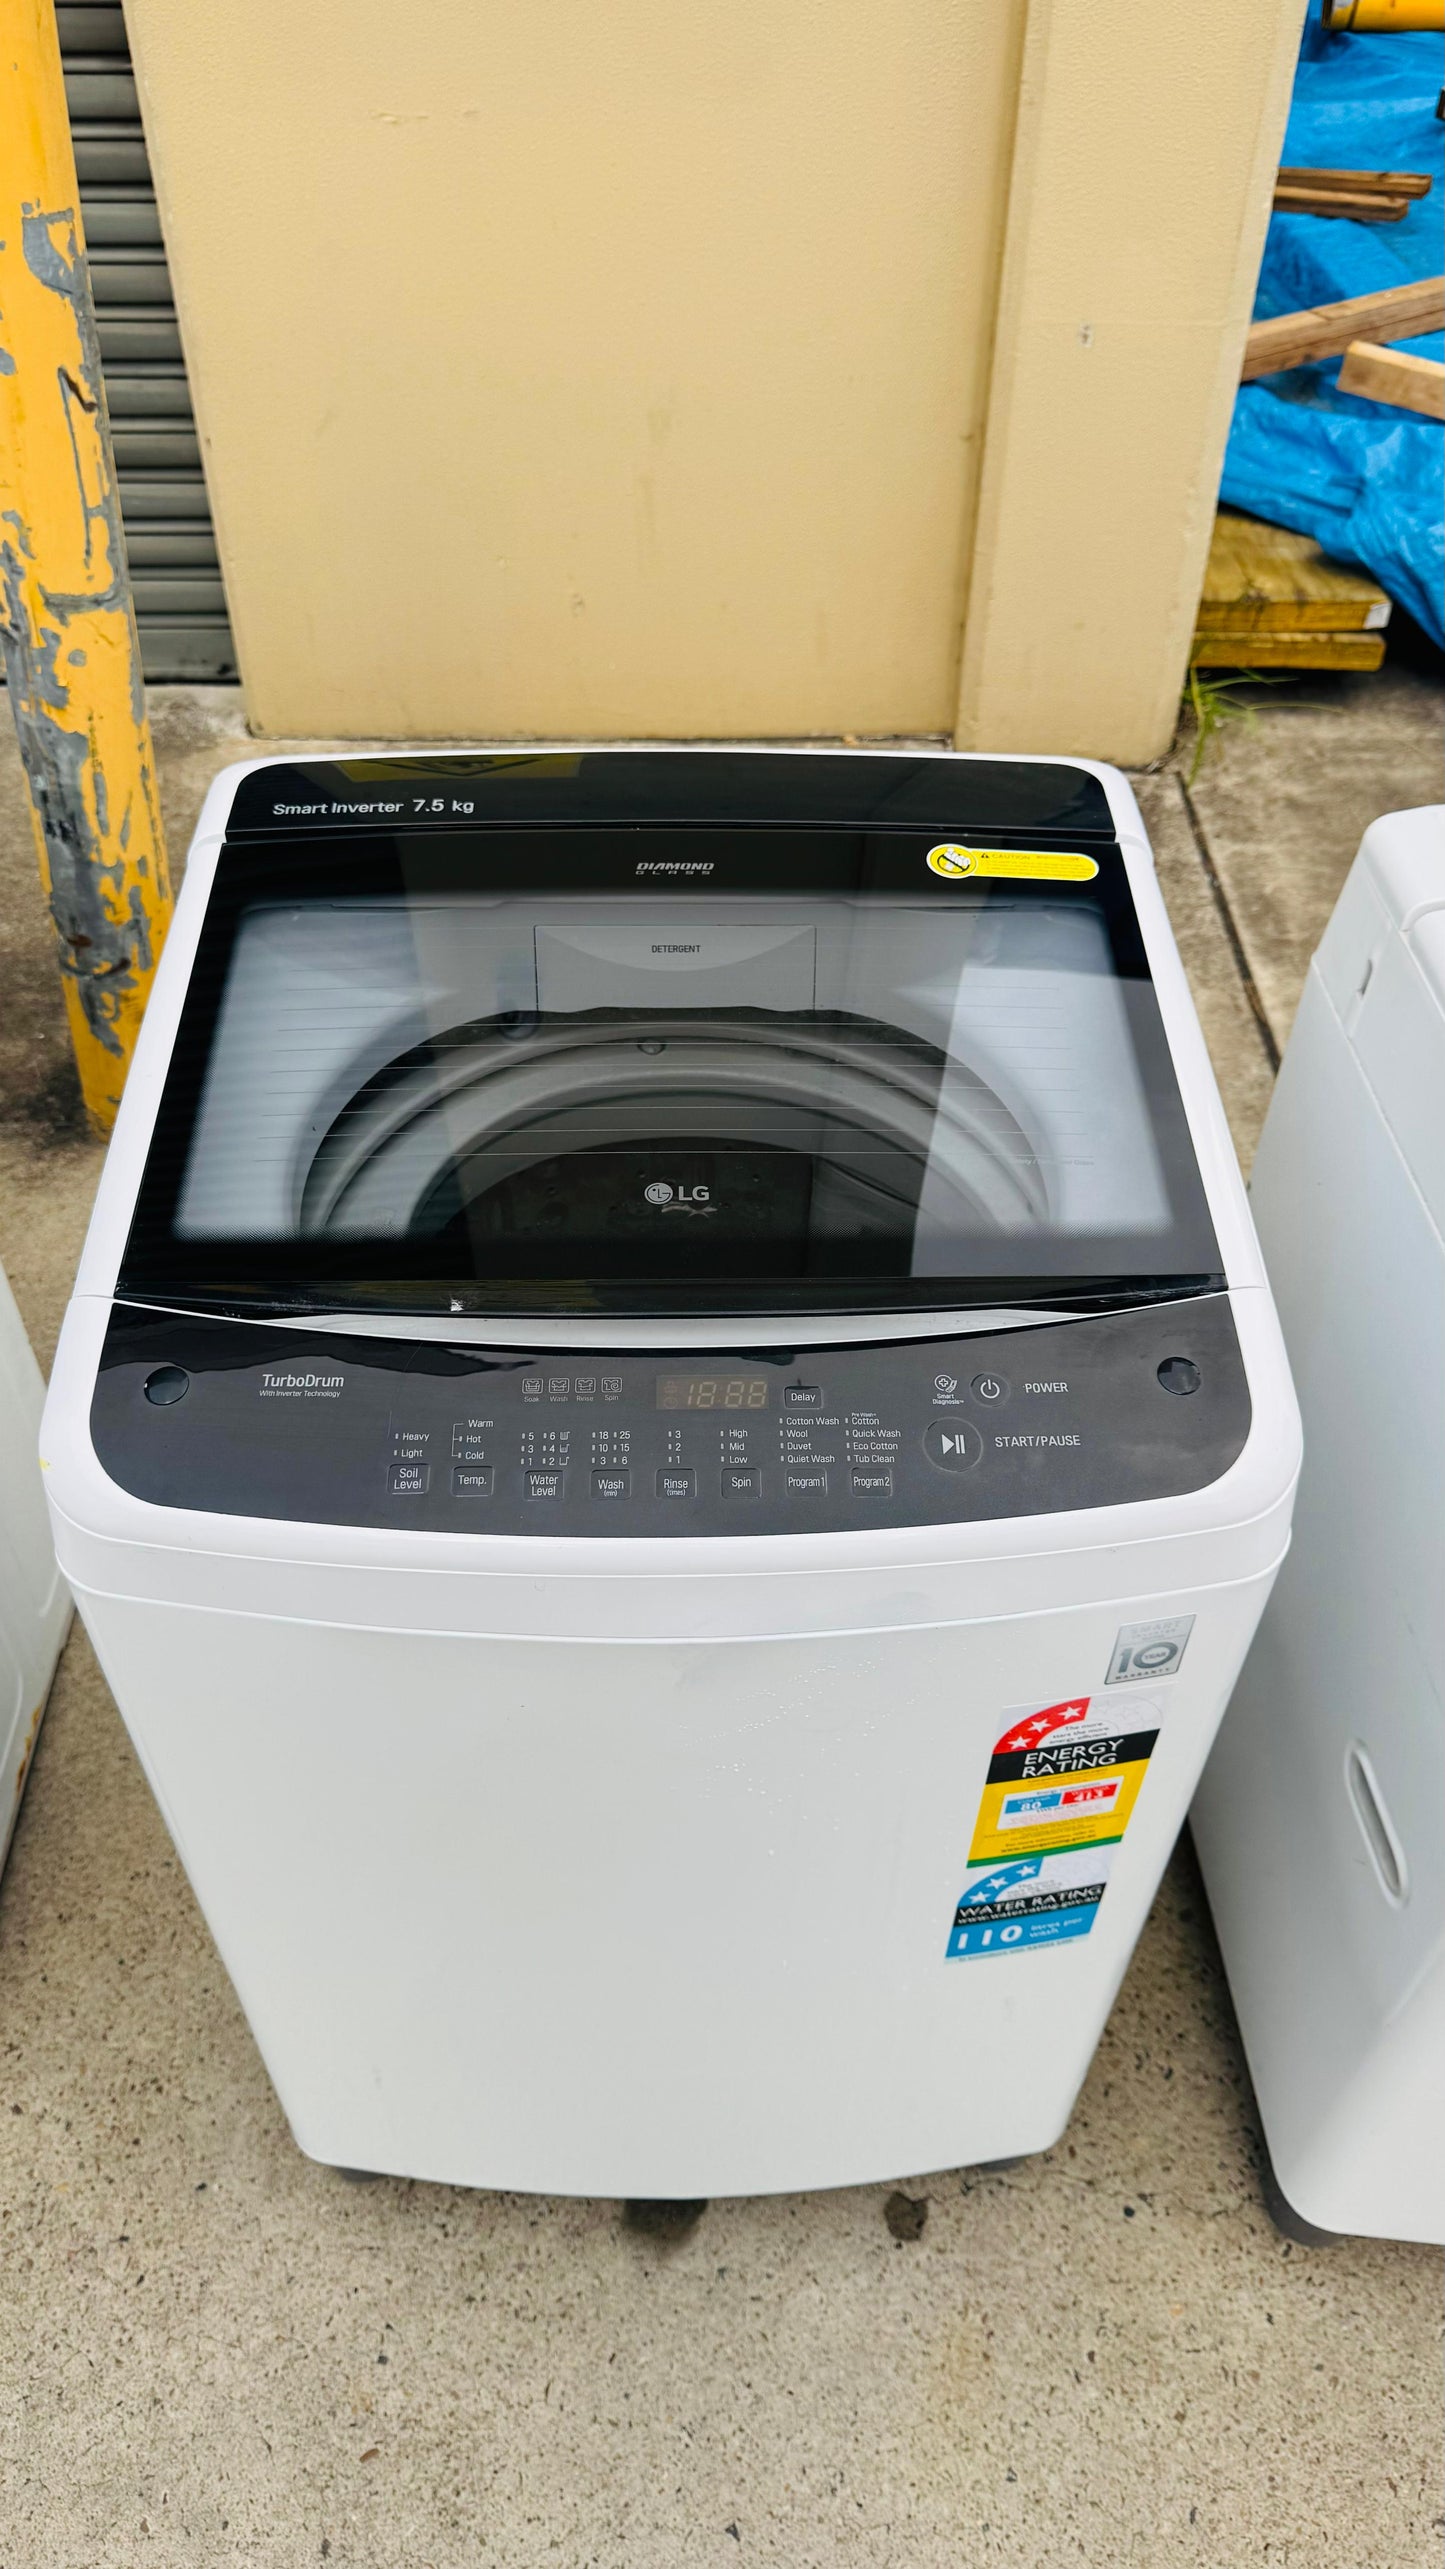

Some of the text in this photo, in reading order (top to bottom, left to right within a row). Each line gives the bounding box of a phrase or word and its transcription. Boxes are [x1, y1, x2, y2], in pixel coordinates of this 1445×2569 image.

[272, 799, 475, 816] Smart Inverter 7.5 kg
[636, 862, 715, 870] DIAMOND
[651, 944, 701, 953] DETERGENT
[678, 1185, 710, 1201] LG
[262, 1374, 344, 1387] TurboDrum
[1025, 1382, 1069, 1394] POWER
[304, 1390, 340, 1398] Technology
[791, 1392, 816, 1402] Delay
[468, 1419, 494, 1428] Warm
[786, 1417, 840, 1425] Cotton Wash
[851, 1417, 880, 1425] Cotton
[402, 1432, 430, 1442] Heavy
[528, 1432, 555, 1441] 5 6
[599, 1431, 631, 1440] 18 25
[675, 1430, 681, 1439] 3
[729, 1429, 748, 1439] High
[852, 1429, 901, 1438] Quick Wash
[466, 1434, 482, 1443] Hot
[995, 1435, 1081, 1448] START/PAUSE
[527, 1444, 555, 1453] 3 4
[598, 1444, 630, 1452] 10 15
[675, 1443, 681, 1451] 2
[729, 1442, 745, 1451] Mid
[787, 1442, 812, 1450] Duvet
[853, 1442, 898, 1450] Eco Cotton
[401, 1449, 423, 1458] Light
[465, 1451, 484, 1460] Cold
[548, 1457, 555, 1465] 2
[600, 1456, 627, 1465] 3 6
[675, 1455, 681, 1464] 1
[729, 1455, 748, 1464] Low
[787, 1455, 809, 1463] Quiet
[854, 1455, 895, 1463] Tub Clean
[399, 1467, 418, 1479] Soil
[394, 1479, 422, 1490] Level
[458, 1474, 487, 1487] Temp.
[529, 1475, 558, 1486] Water
[598, 1479, 624, 1490] Wash
[663, 1479, 688, 1489] Rinse
[731, 1477, 752, 1488] Spin
[531, 1485, 556, 1497] Level
[604, 1489, 618, 1497] (min)
[666, 1488, 686, 1497] (times)
[1118, 1641, 1179, 1673] 10
[1024, 1738, 1124, 1765] ENERGY
[1022, 1752, 1117, 1778] RATING
[1021, 1801, 1042, 1811] 80
[959, 1901, 1026, 1918] WATER
[1031, 1886, 1102, 1906] RATING
[957, 1925, 1023, 1950] 110
